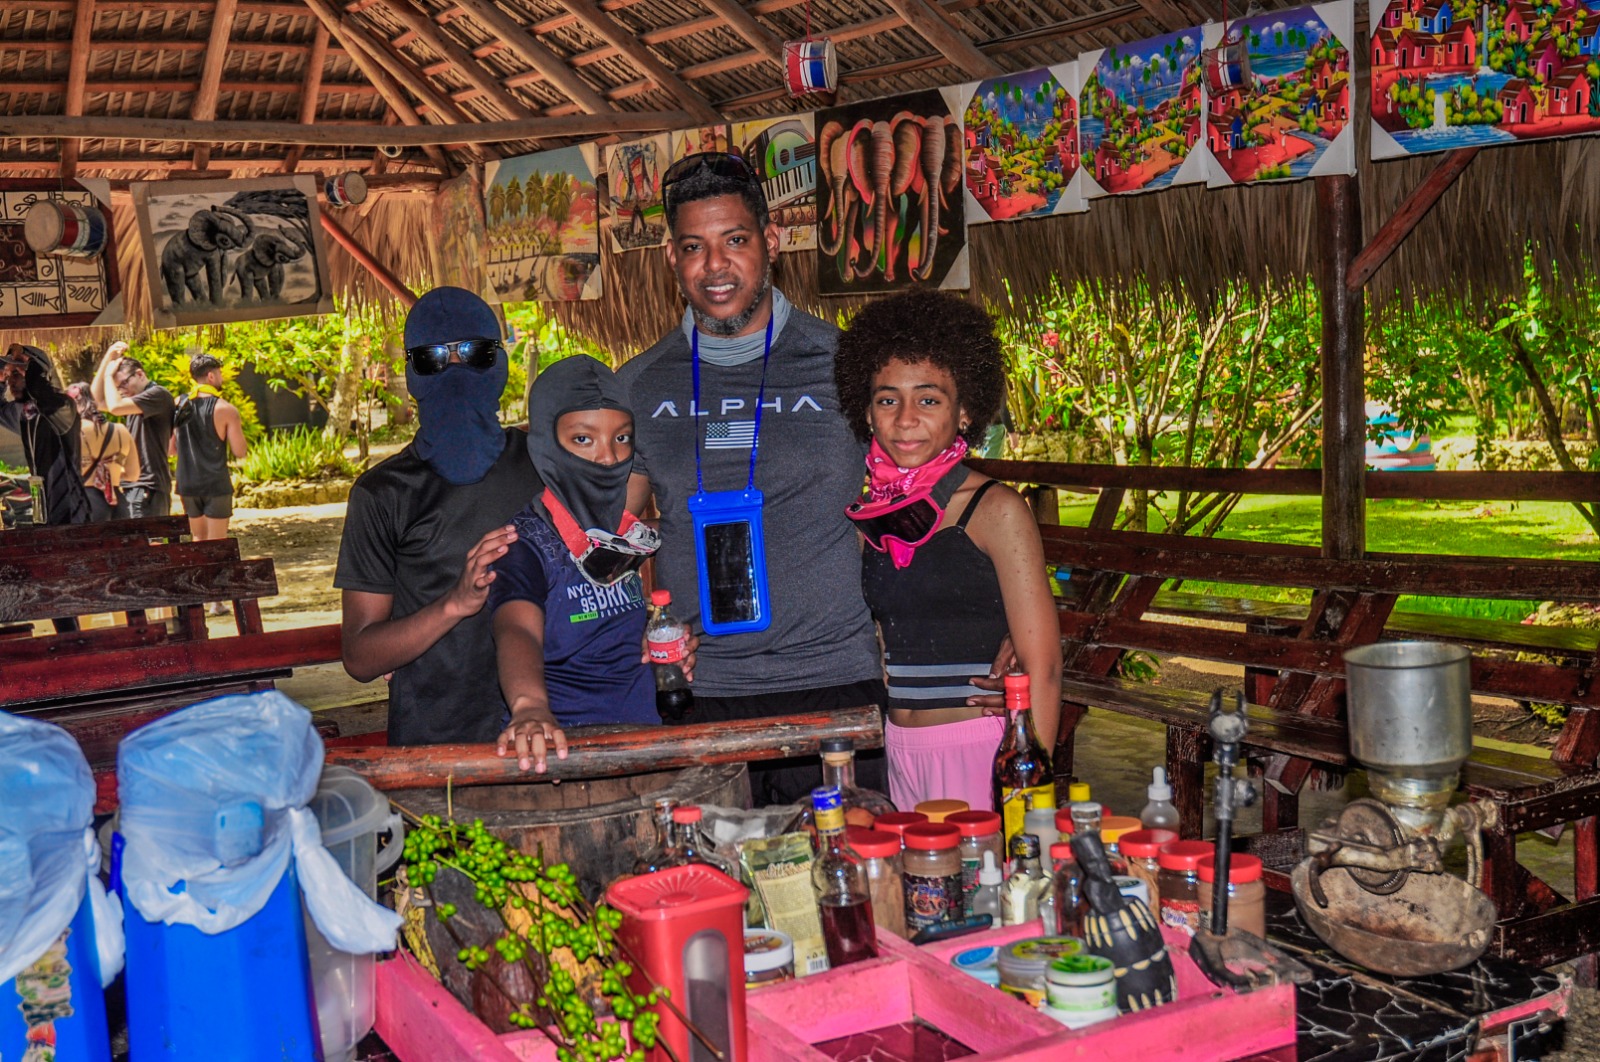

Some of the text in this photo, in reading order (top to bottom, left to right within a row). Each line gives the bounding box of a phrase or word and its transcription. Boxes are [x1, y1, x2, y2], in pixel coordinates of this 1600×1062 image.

[651, 395, 823, 419] ALPHA
[567, 584, 592, 600] NYC
[580, 596, 598, 613] 95
